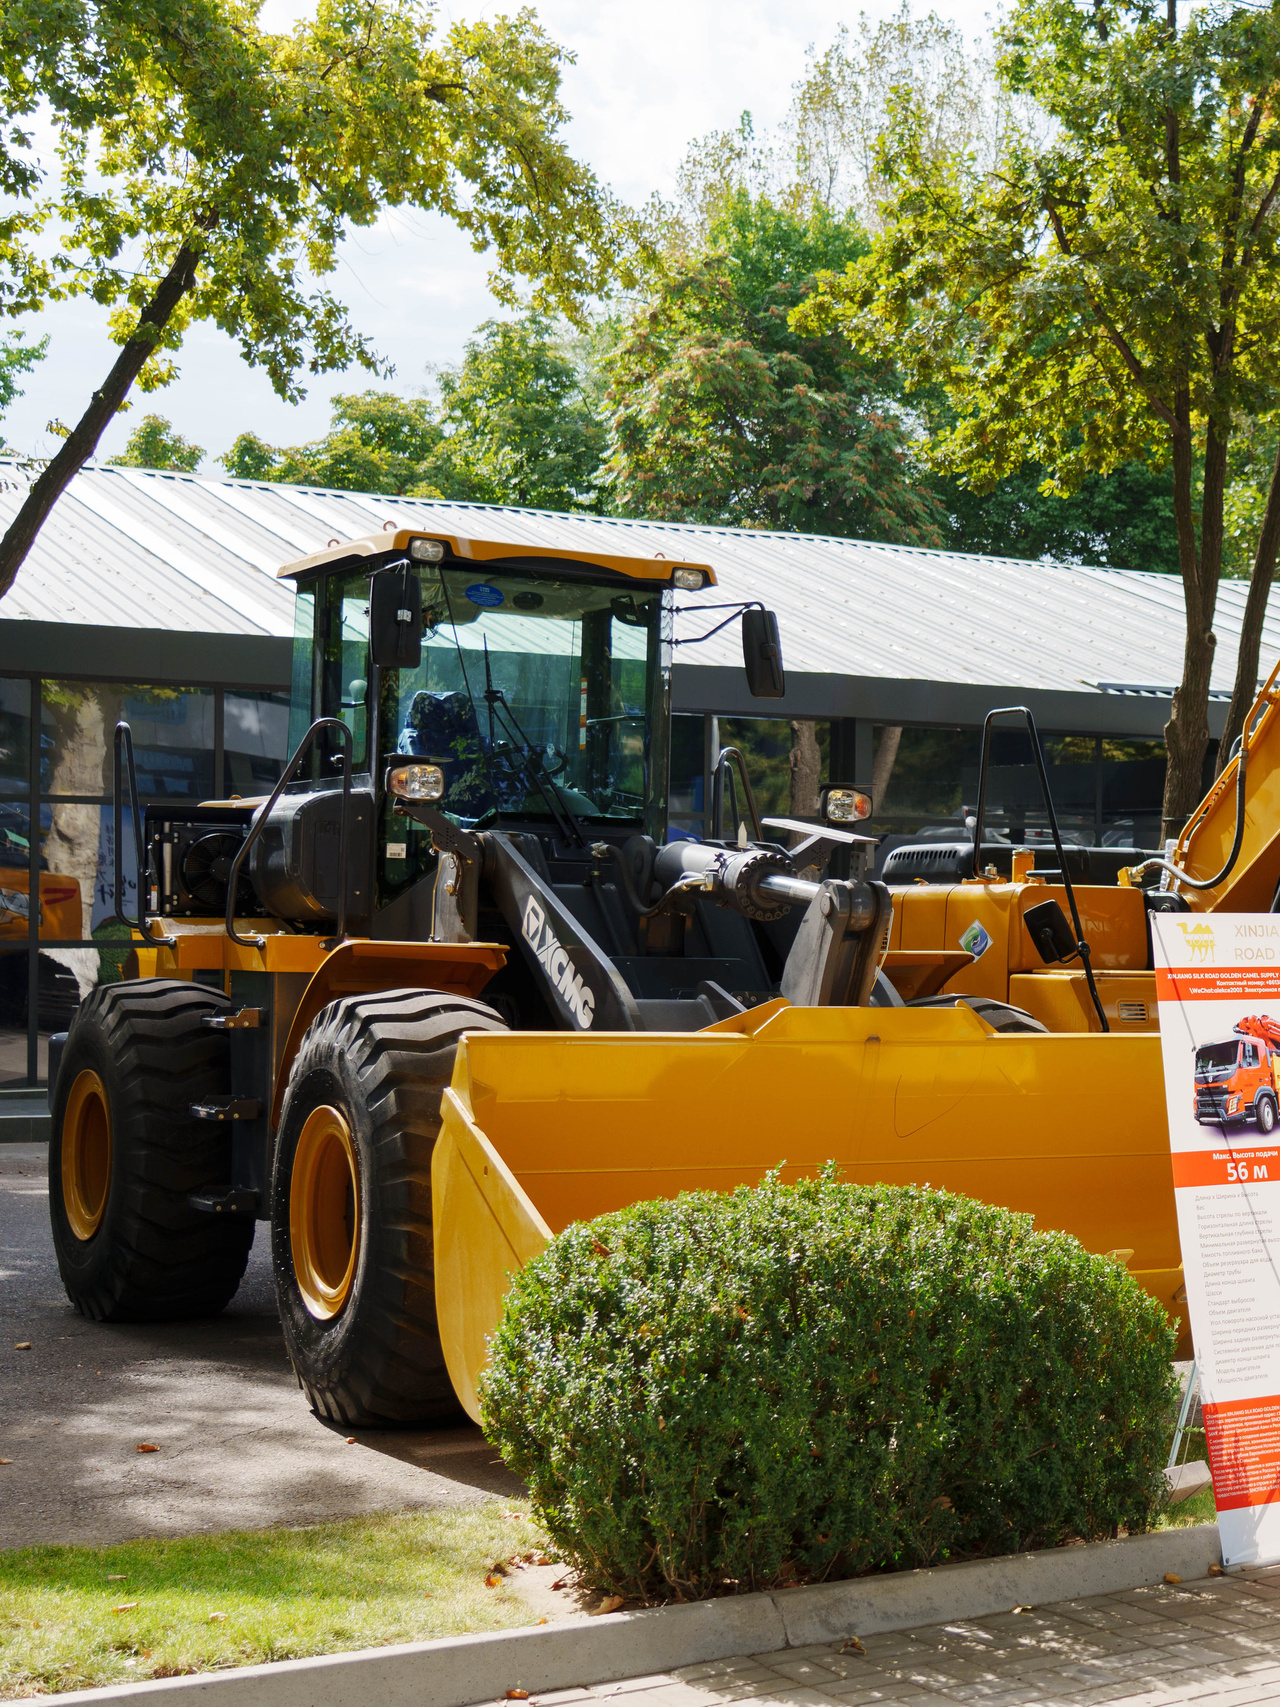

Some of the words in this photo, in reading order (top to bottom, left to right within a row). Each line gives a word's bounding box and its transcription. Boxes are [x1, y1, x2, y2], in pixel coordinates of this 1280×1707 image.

[1233, 947, 1275, 960] ROAD
[536, 924, 595, 1029] XCMG
[1212, 1152, 1231, 1160] Макс.
[1232, 1151, 1254, 1159] Высота
[1255, 1149, 1278, 1158] подачи
[1226, 1161, 1249, 1180] 56
